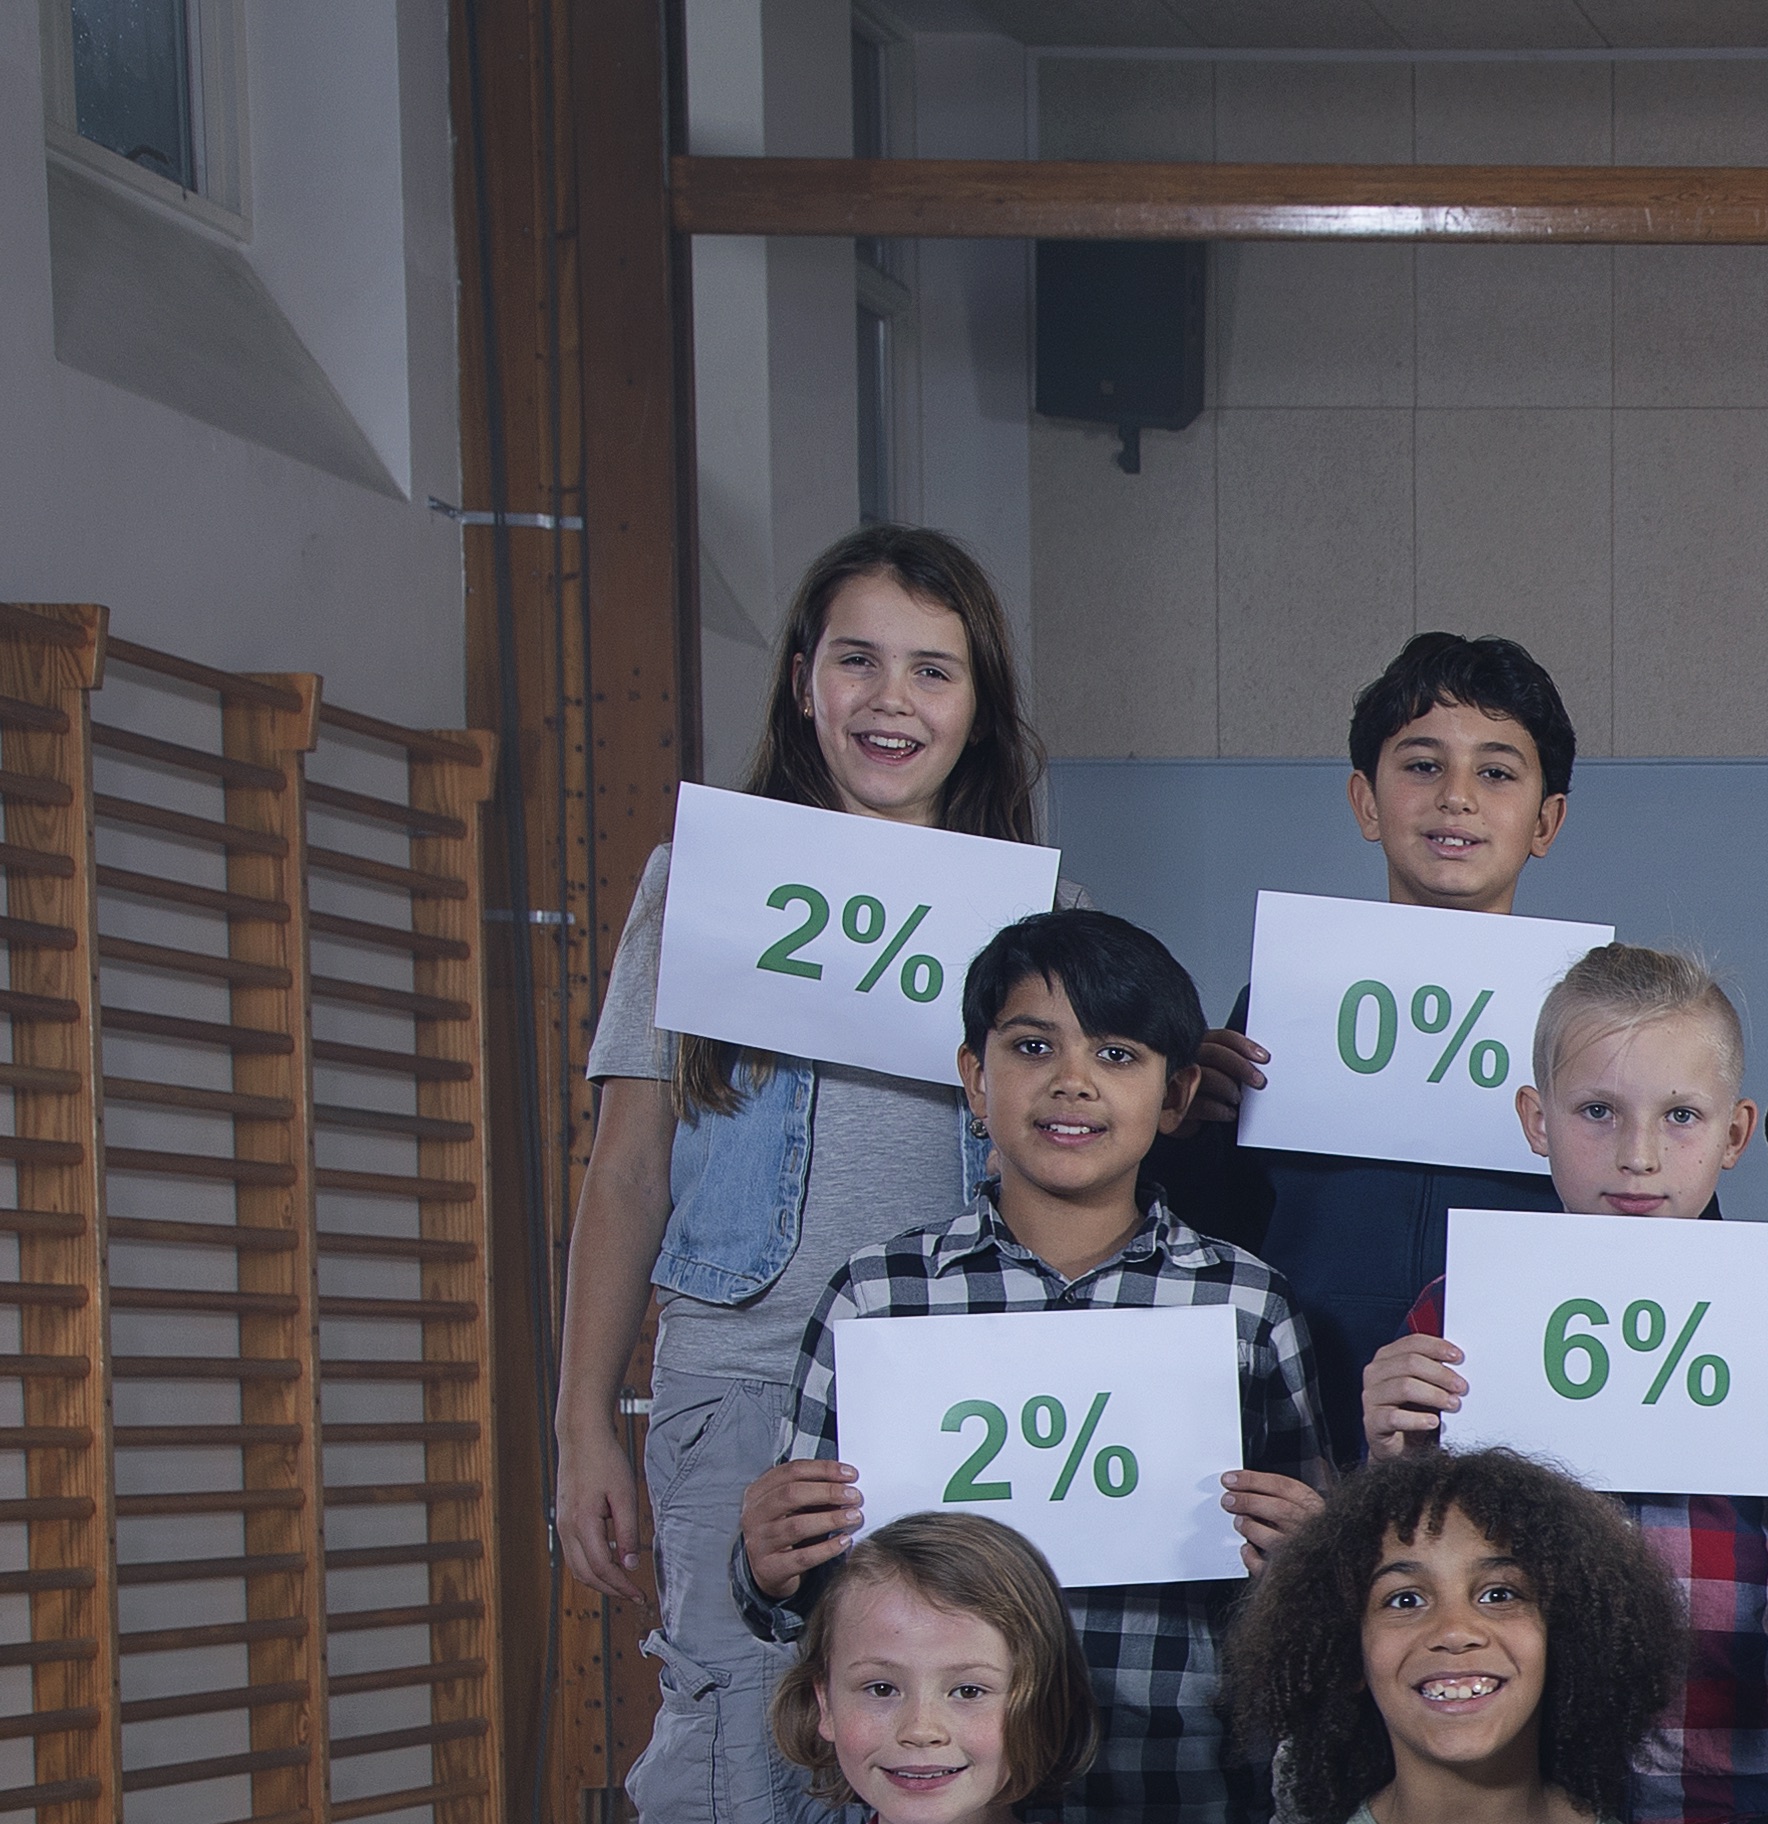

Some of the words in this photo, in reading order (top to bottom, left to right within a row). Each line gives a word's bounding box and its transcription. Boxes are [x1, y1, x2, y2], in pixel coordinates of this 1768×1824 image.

[757, 885, 942, 1001] 2%
[1337, 982, 1508, 1086] 0%
[1543, 1298, 1729, 1406] 6%
[942, 1393, 1137, 1502] 2%
